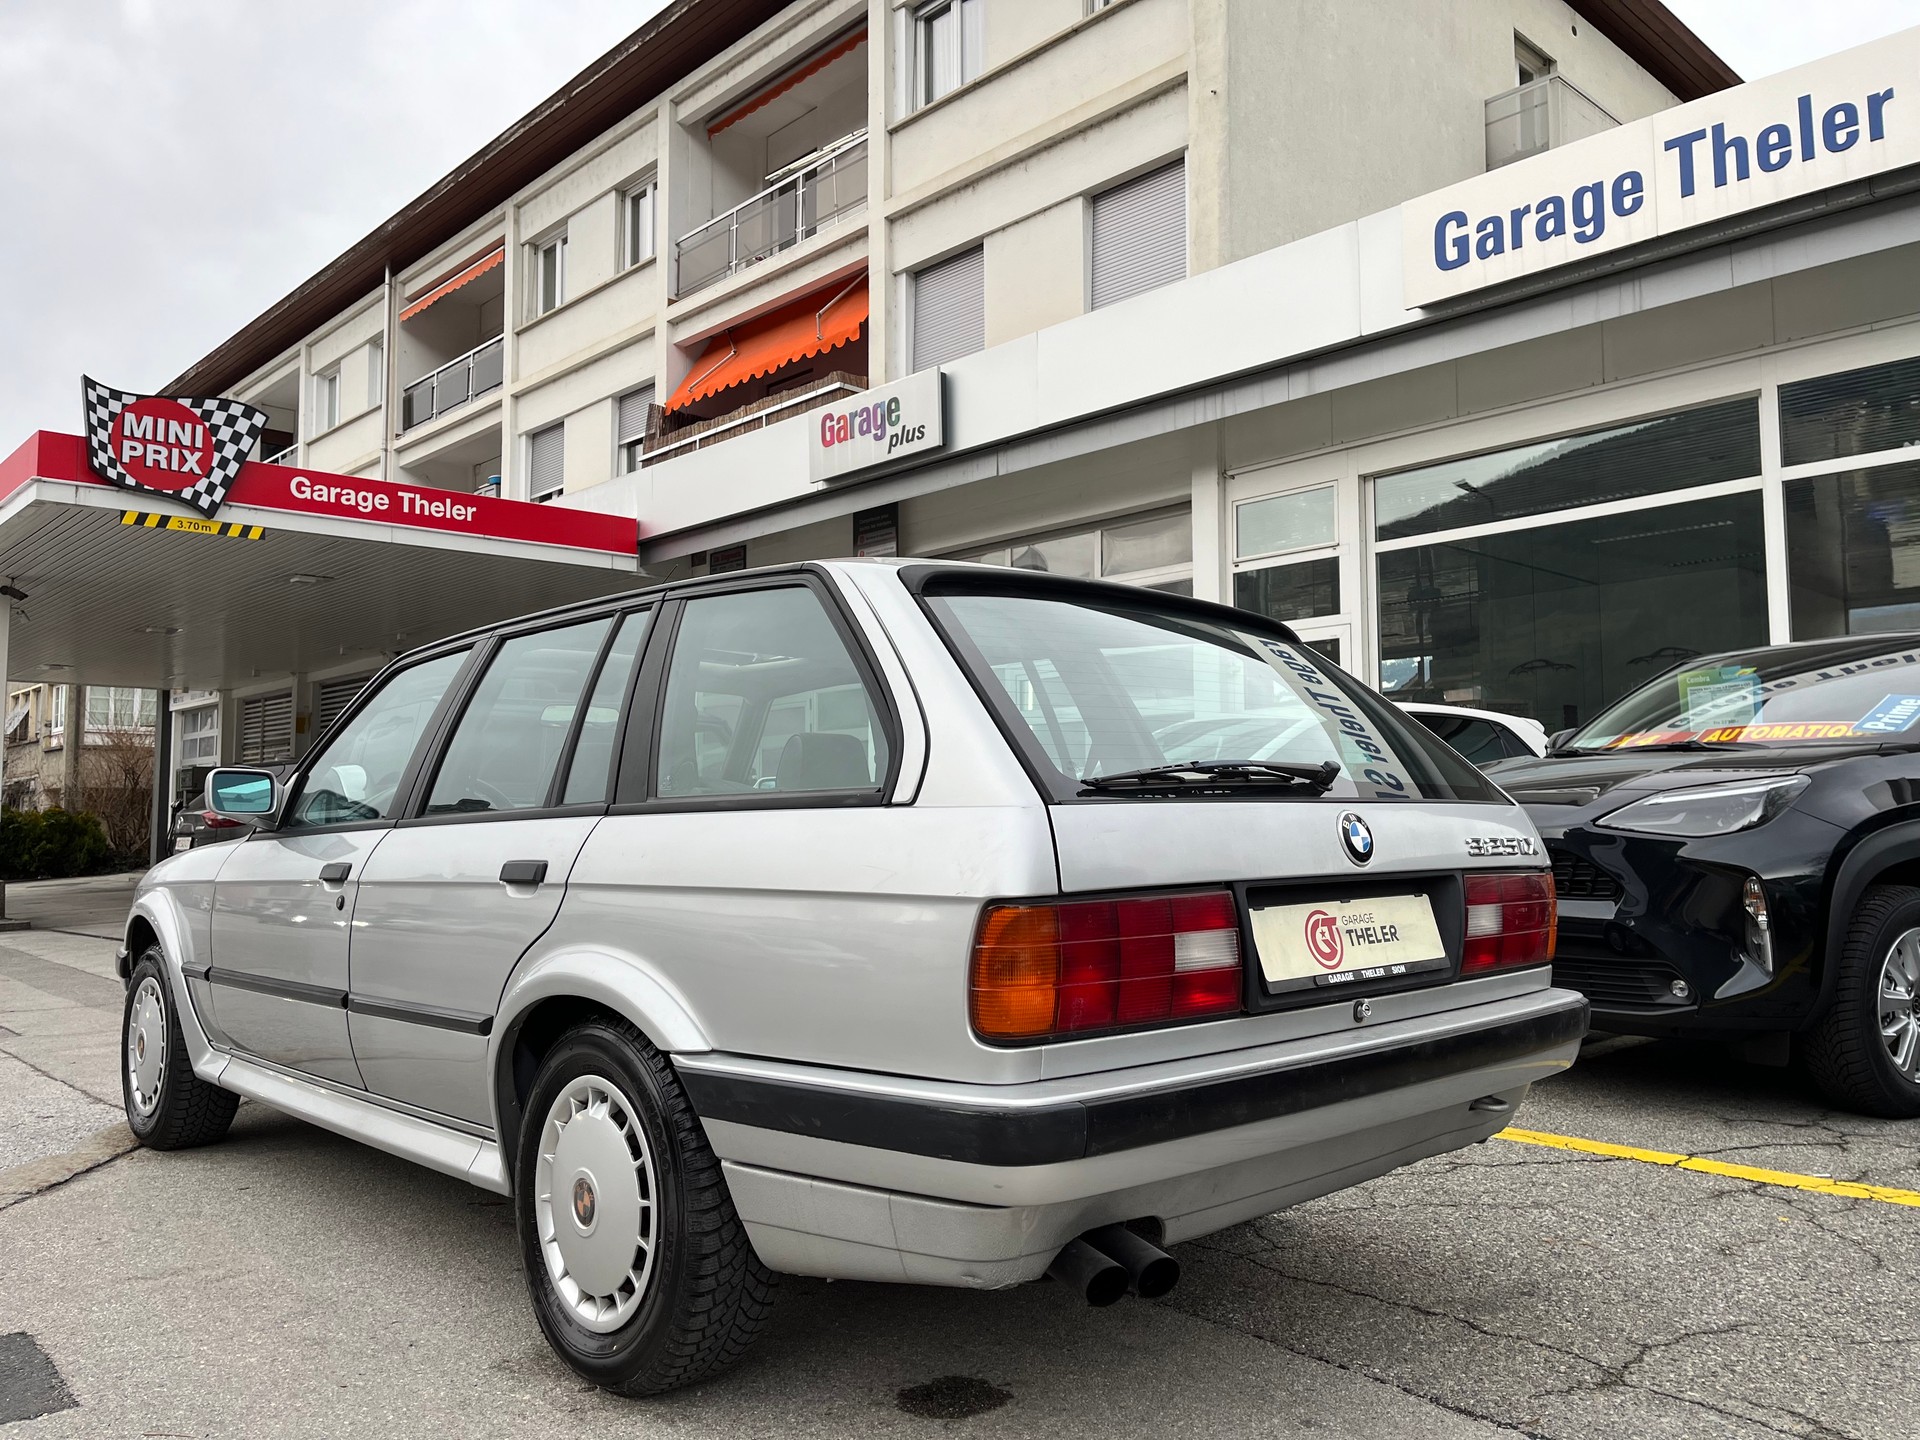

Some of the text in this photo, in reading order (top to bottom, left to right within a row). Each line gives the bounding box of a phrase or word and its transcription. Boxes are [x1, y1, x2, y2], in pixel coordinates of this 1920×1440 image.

[1434, 87, 1895, 272] Garage Theler
[122, 411, 204, 449] MINI
[820, 396, 901, 448] Garage
[887, 424, 926, 455] plus
[121, 439, 203, 475] PRIX
[289, 476, 477, 522] Garage Theler
[1862, 698, 1920, 731] Prime
[1341, 912, 1375, 926] GARAGE
[1345, 924, 1400, 947] THELER
[1328, 964, 1406, 984] GARAGE THELER SION
